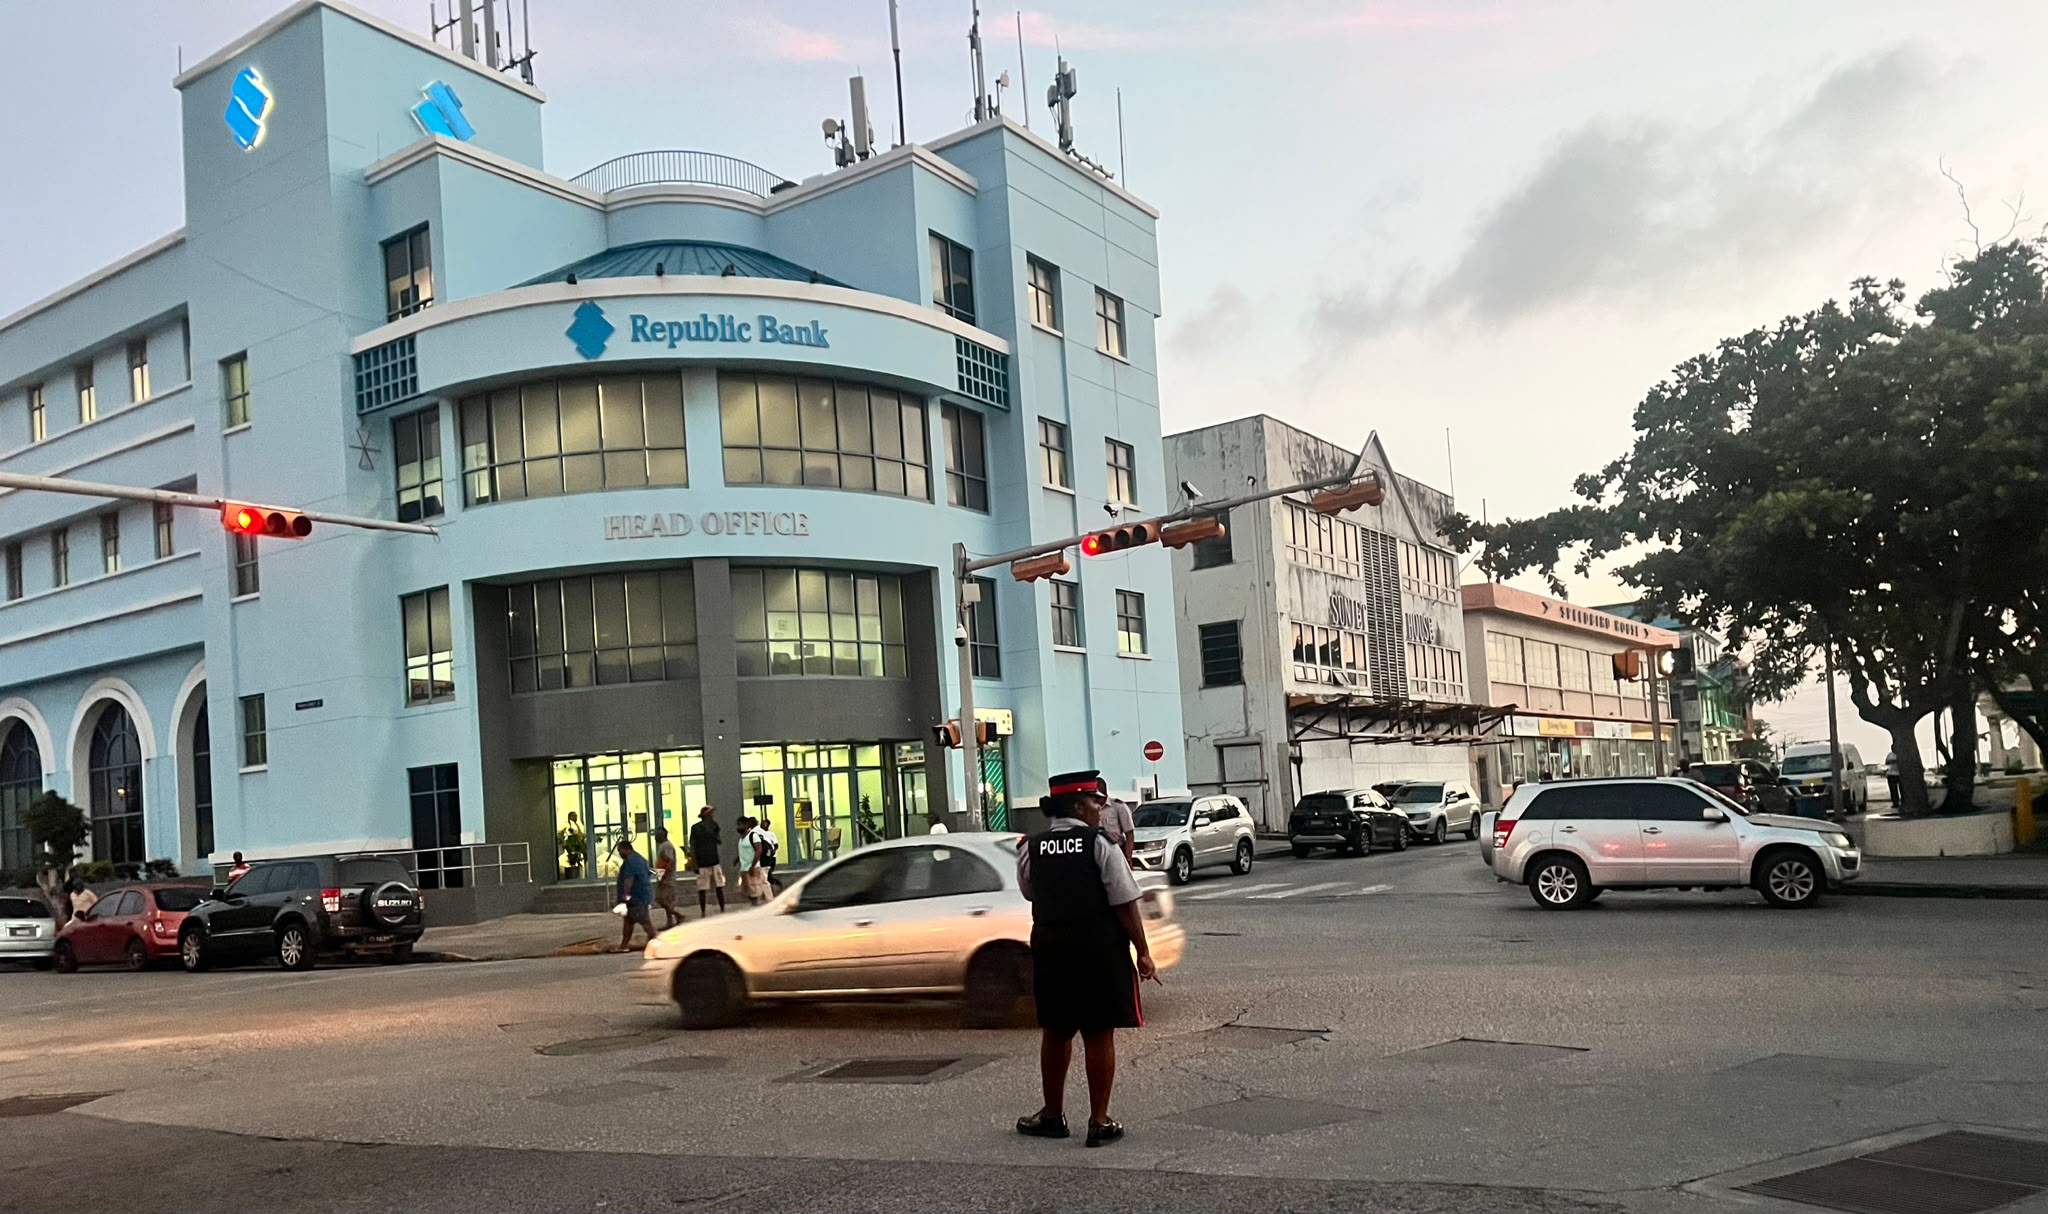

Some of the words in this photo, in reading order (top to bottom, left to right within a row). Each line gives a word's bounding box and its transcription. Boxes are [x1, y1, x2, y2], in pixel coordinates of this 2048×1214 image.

[630, 313, 751, 349] Republic
[757, 314, 830, 348] Bank
[603, 512, 694, 541] HEAD
[700, 511, 809, 536] OFFICE
[1404, 612, 1435, 643] HOUSE
[1040, 837, 1083, 855] POLICE
[377, 899, 412, 907] SUZUKI
